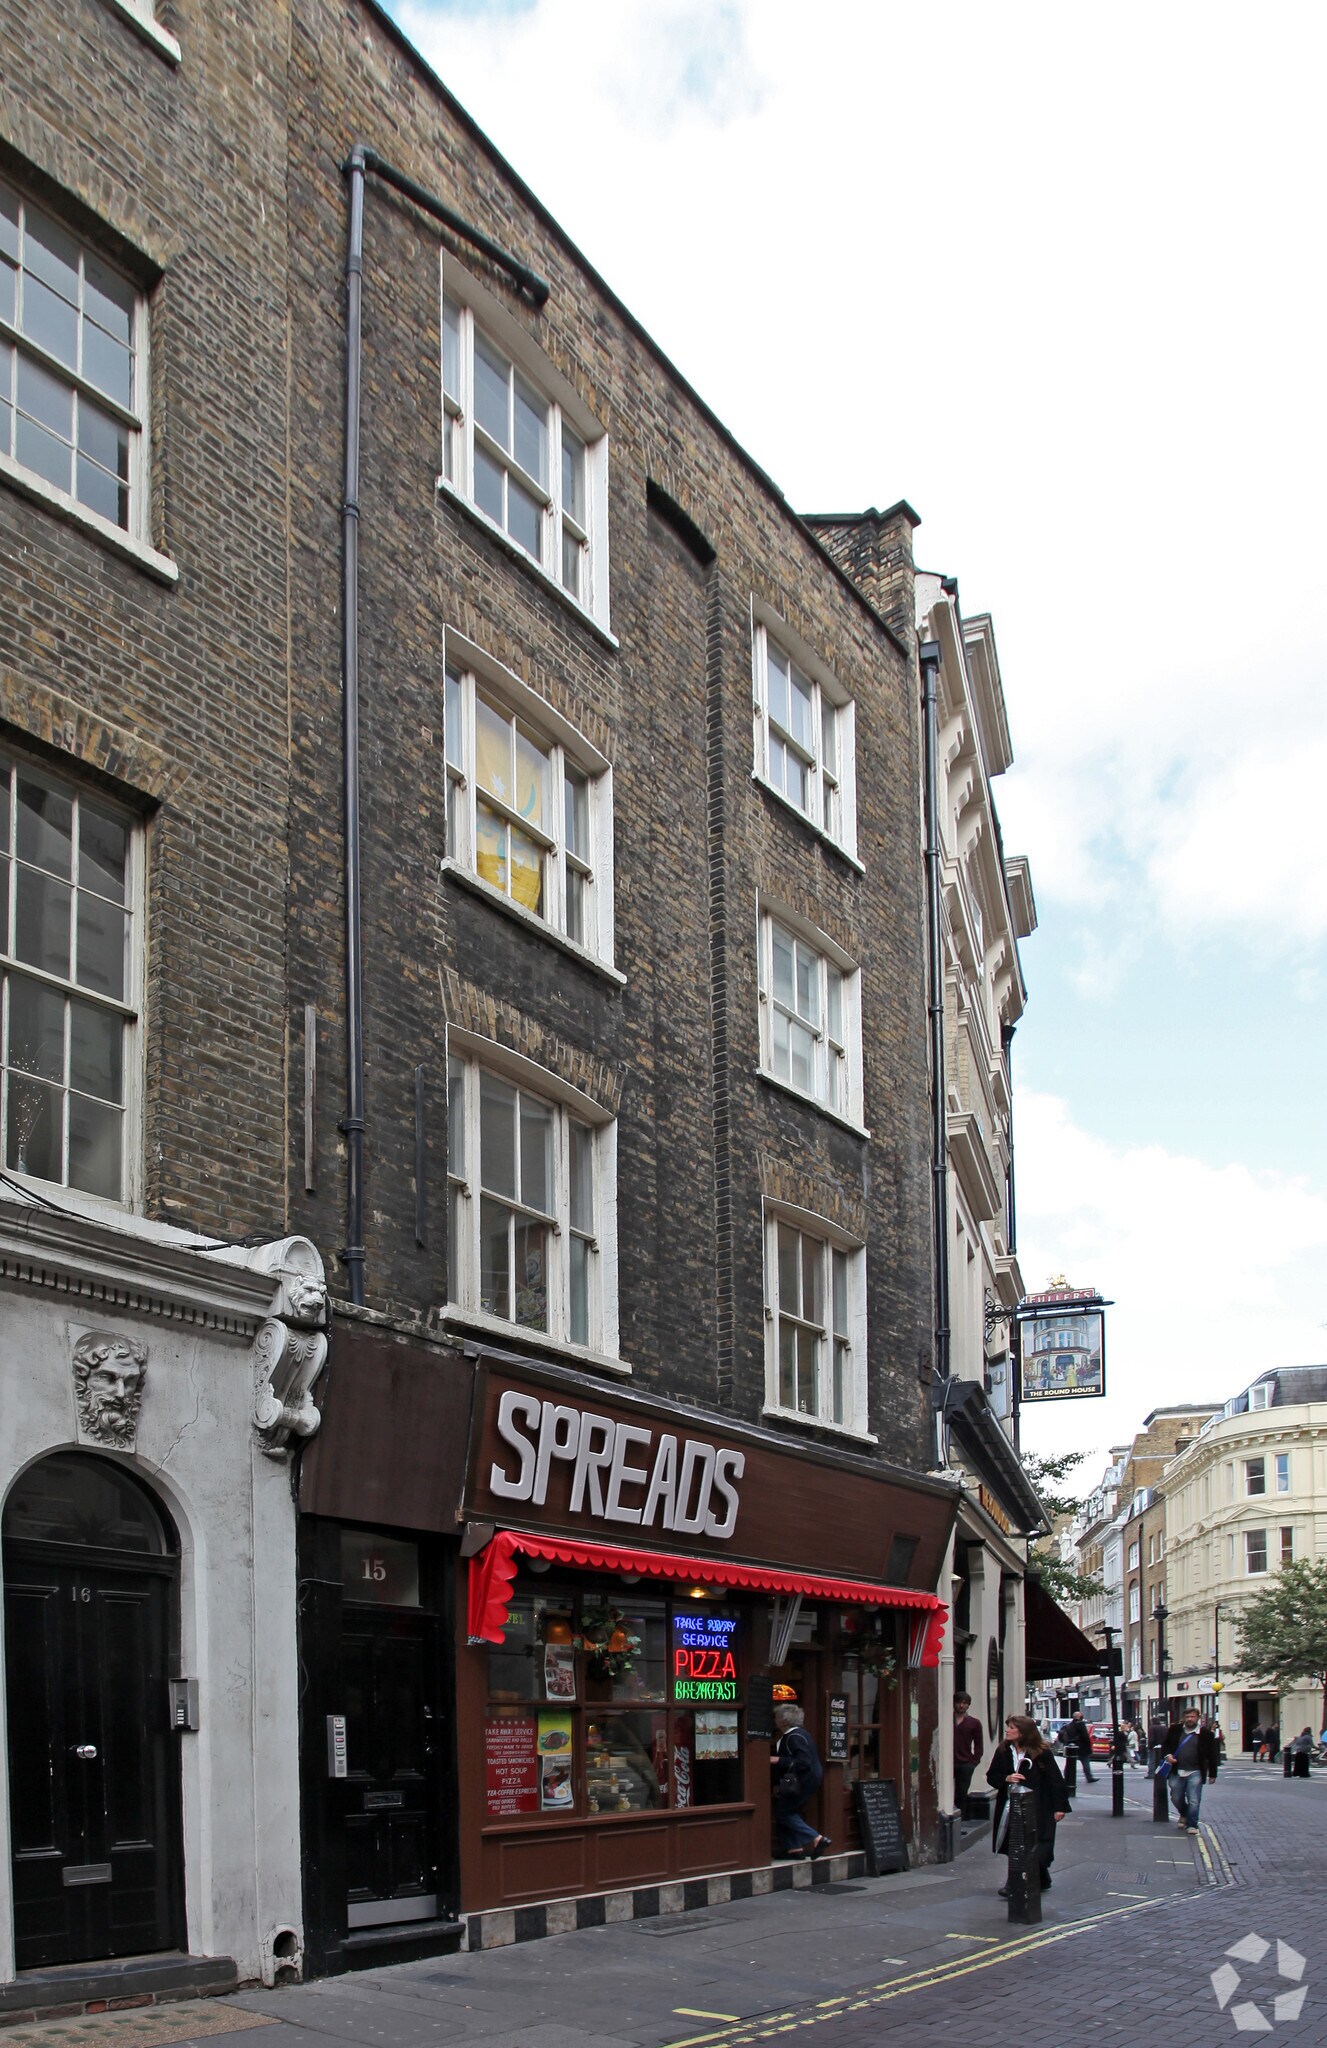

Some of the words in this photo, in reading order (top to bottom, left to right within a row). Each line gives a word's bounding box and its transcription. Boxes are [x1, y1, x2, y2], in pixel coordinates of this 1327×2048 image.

[489, 1390, 746, 1539] SPREADS
[361, 1558, 387, 1581] 15
[71, 1586, 91, 1603] 16
[682, 1633, 728, 1648] SERVICE
[675, 1649, 736, 1679] PIZZA
[675, 1680, 736, 1700] BREAKFAST
[485, 1728, 499, 1736] TAKE
[499, 1728, 513, 1736] AWAY
[501, 1777, 521, 1785] PIZZA
